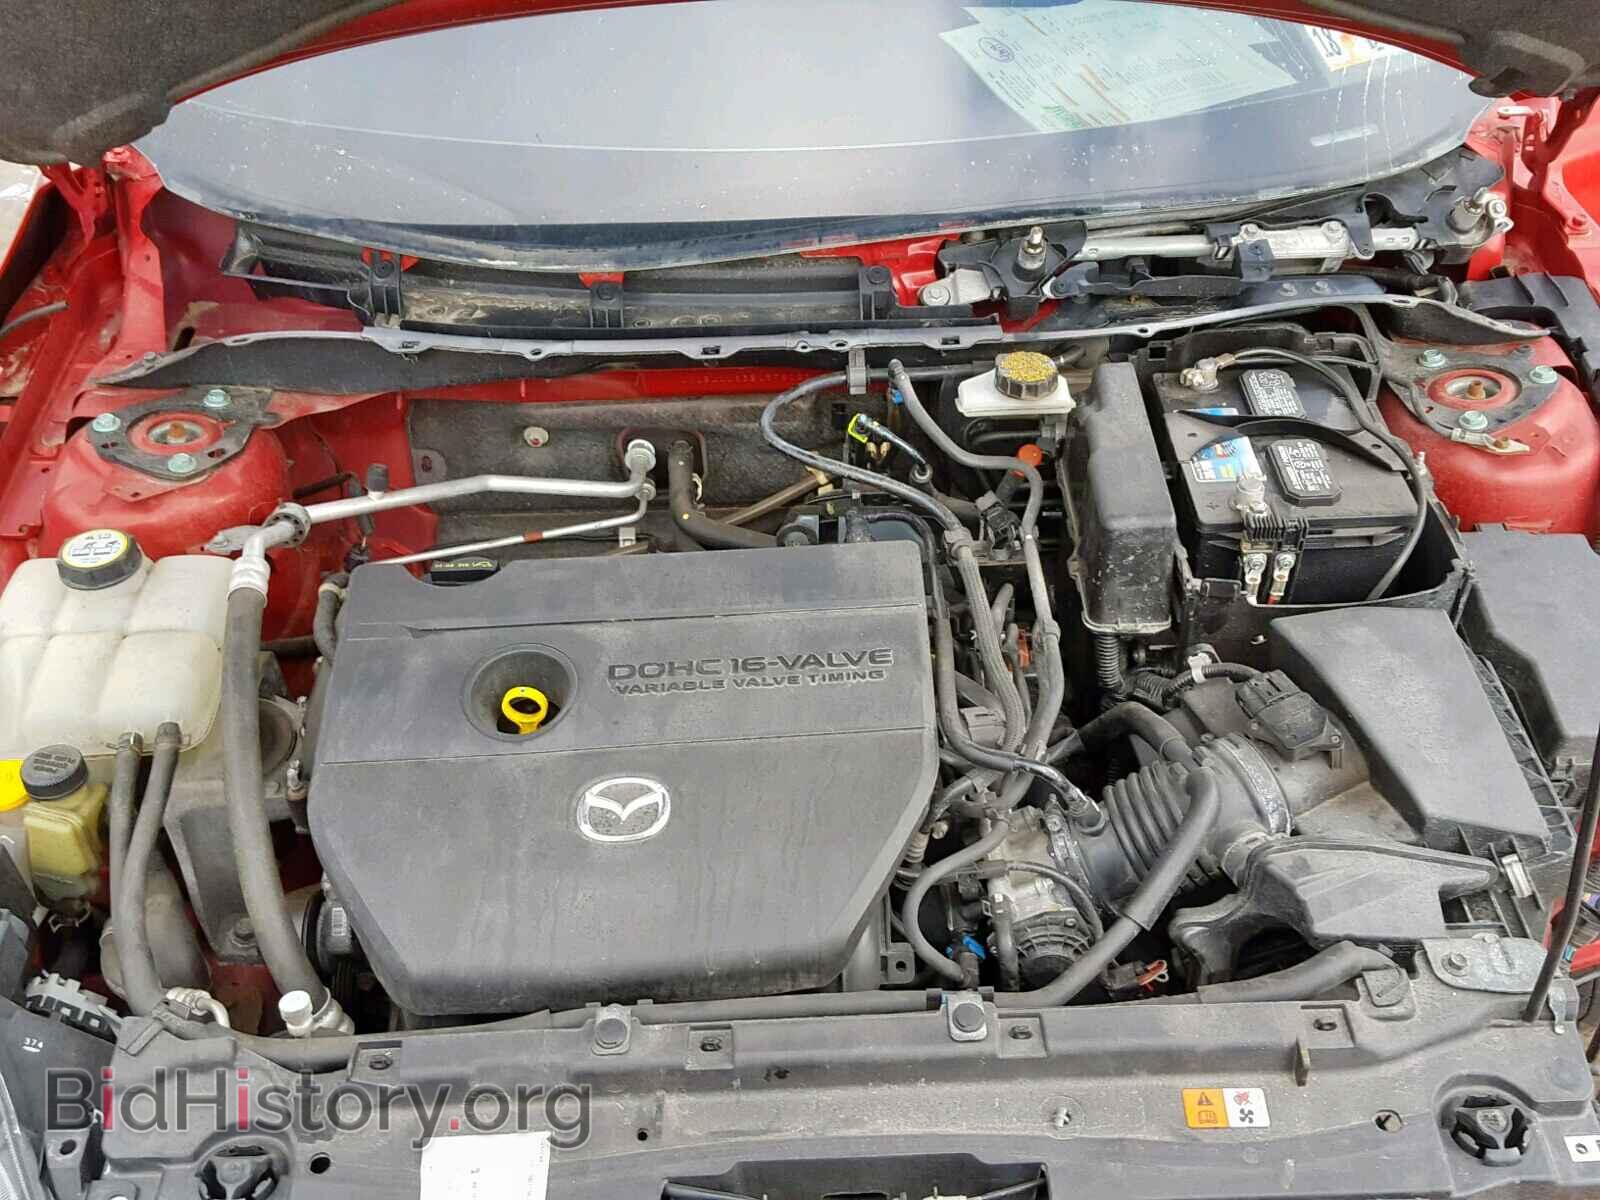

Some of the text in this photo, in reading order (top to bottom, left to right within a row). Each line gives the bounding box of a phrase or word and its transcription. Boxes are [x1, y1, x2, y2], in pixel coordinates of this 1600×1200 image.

[607, 648, 894, 681] DOHC 16-VALVE
[615, 669, 886, 695] VARIABLE VALVE TIMING
